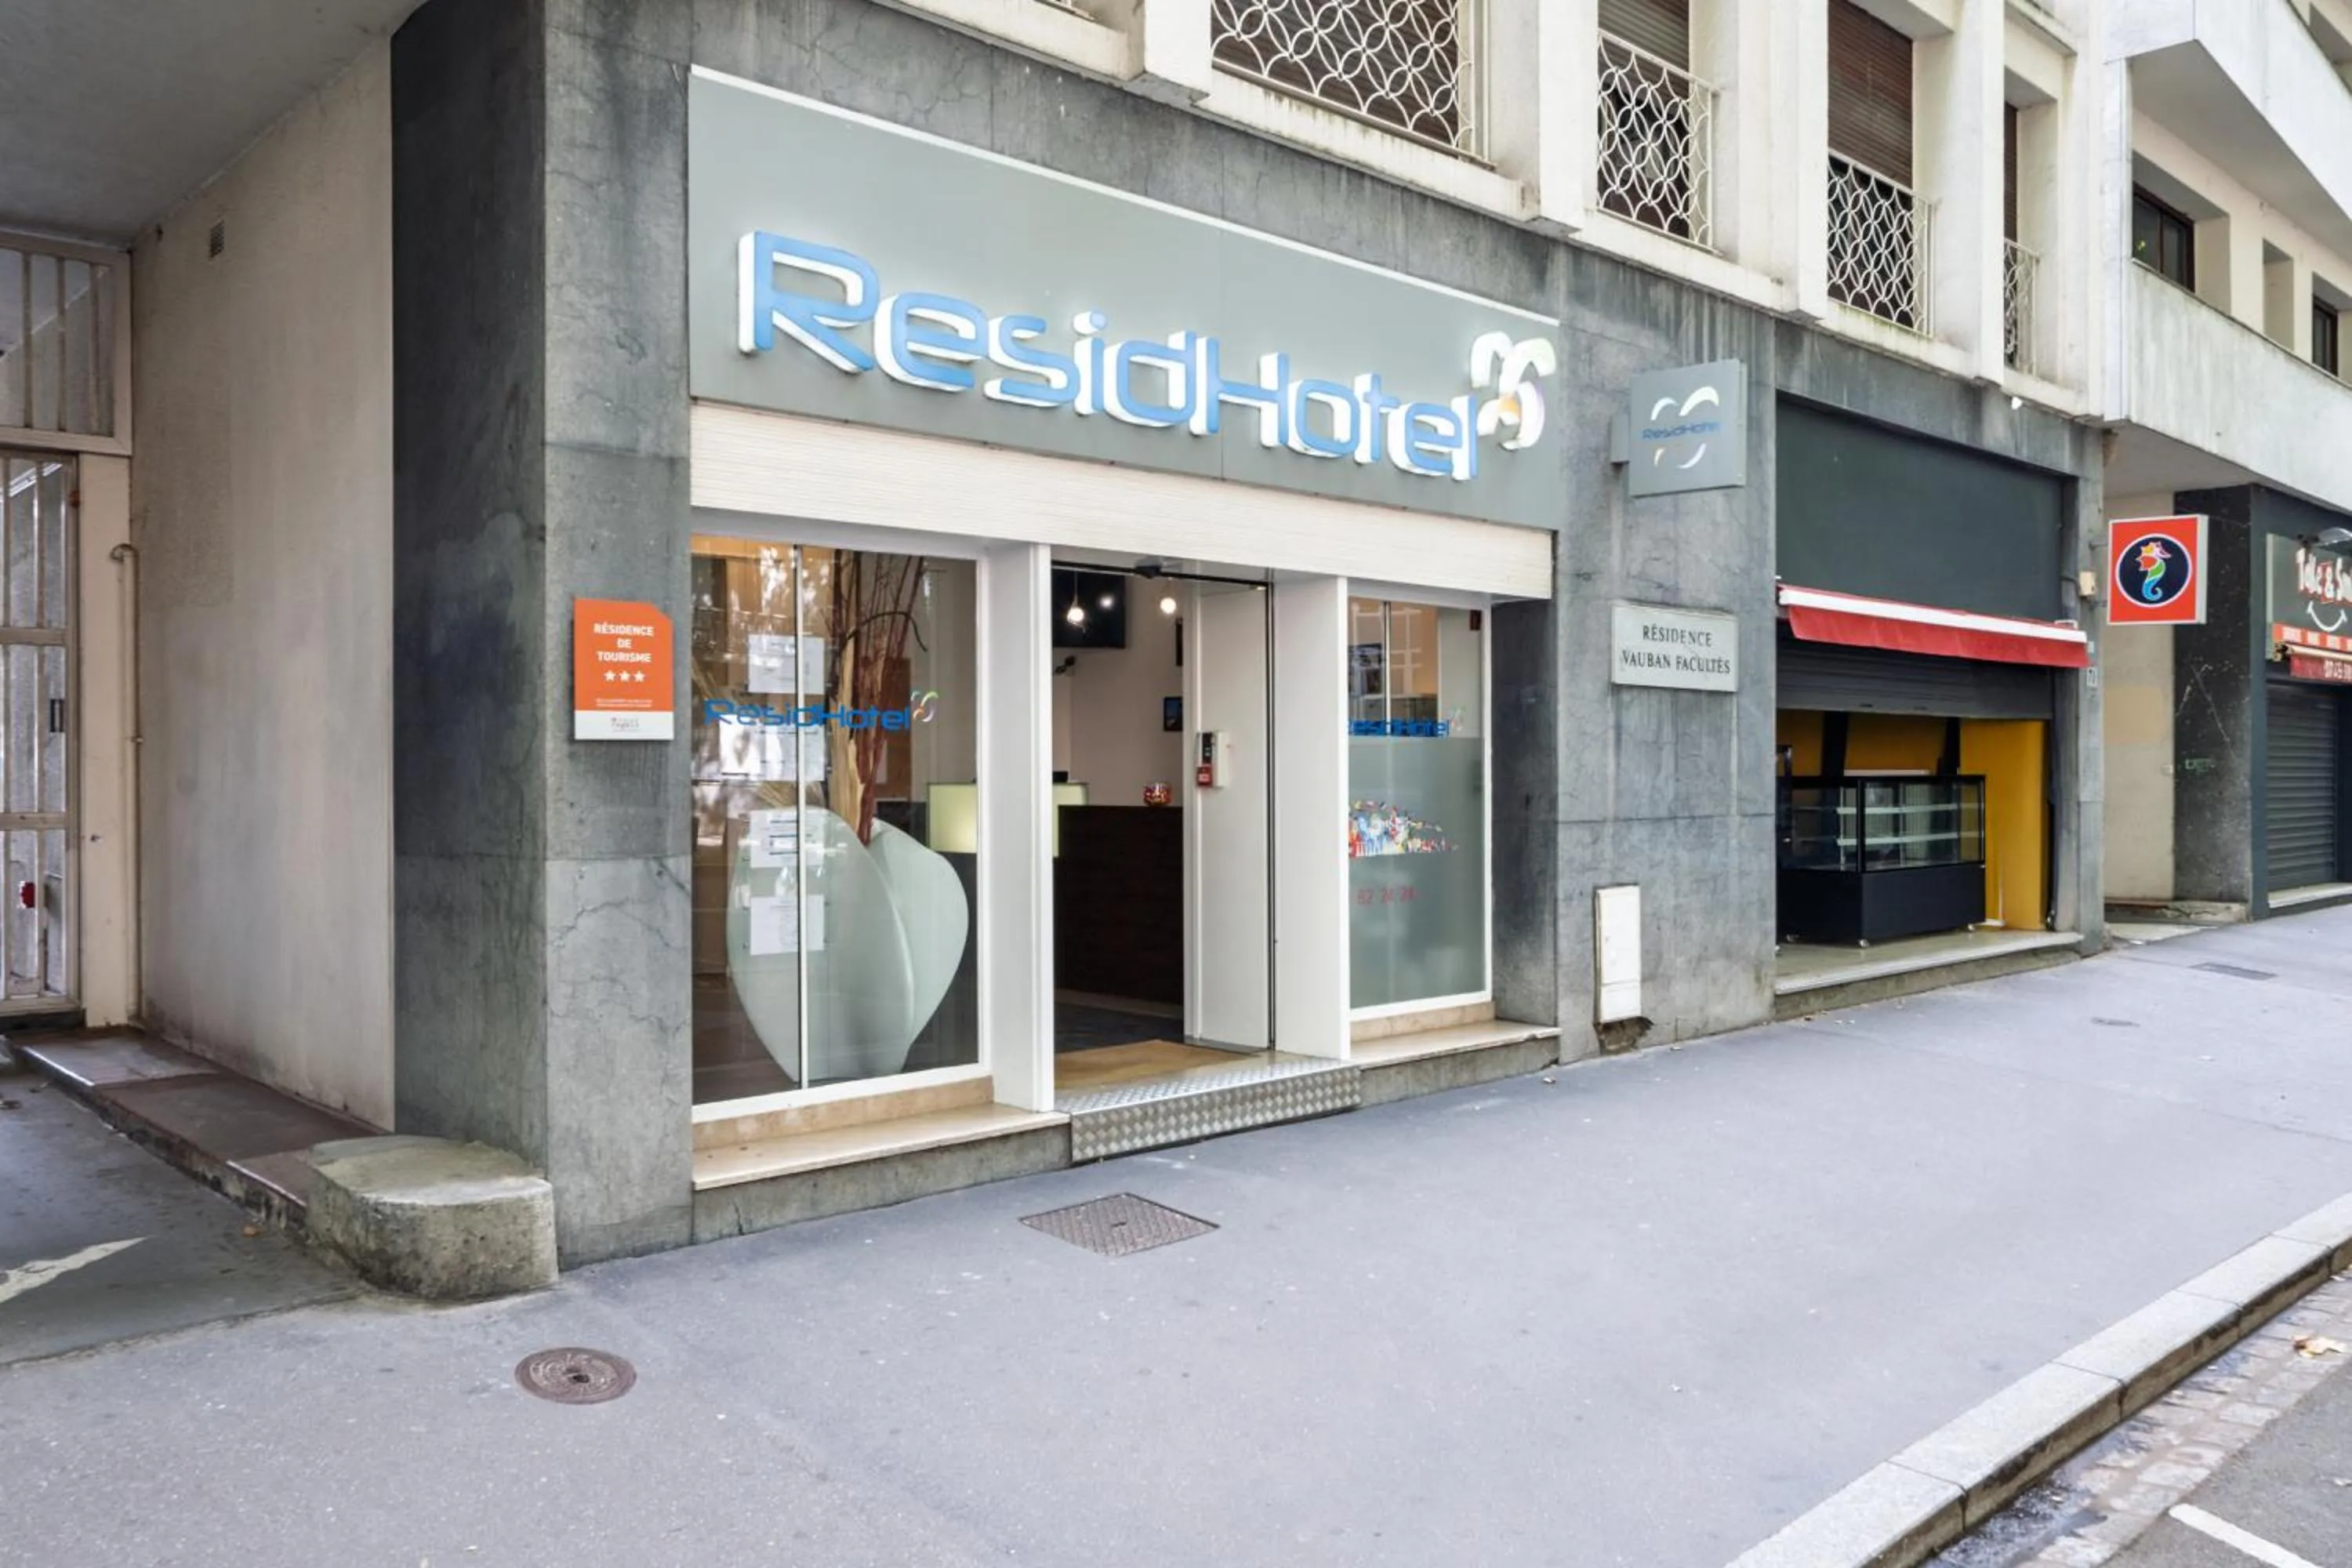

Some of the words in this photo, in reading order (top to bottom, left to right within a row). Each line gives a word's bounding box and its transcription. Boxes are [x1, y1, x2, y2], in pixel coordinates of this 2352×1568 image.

[738, 230, 1479, 481] ResidHotel
[593, 621, 655, 637] RÉSIDENCE
[1642, 622, 1713, 648] RÉSIDENCE
[616, 637, 633, 649] DE
[596, 651, 652, 663] TOURISME
[1621, 649, 1671, 670] VAUBAN
[1675, 655, 1731, 674] FACULTÉS
